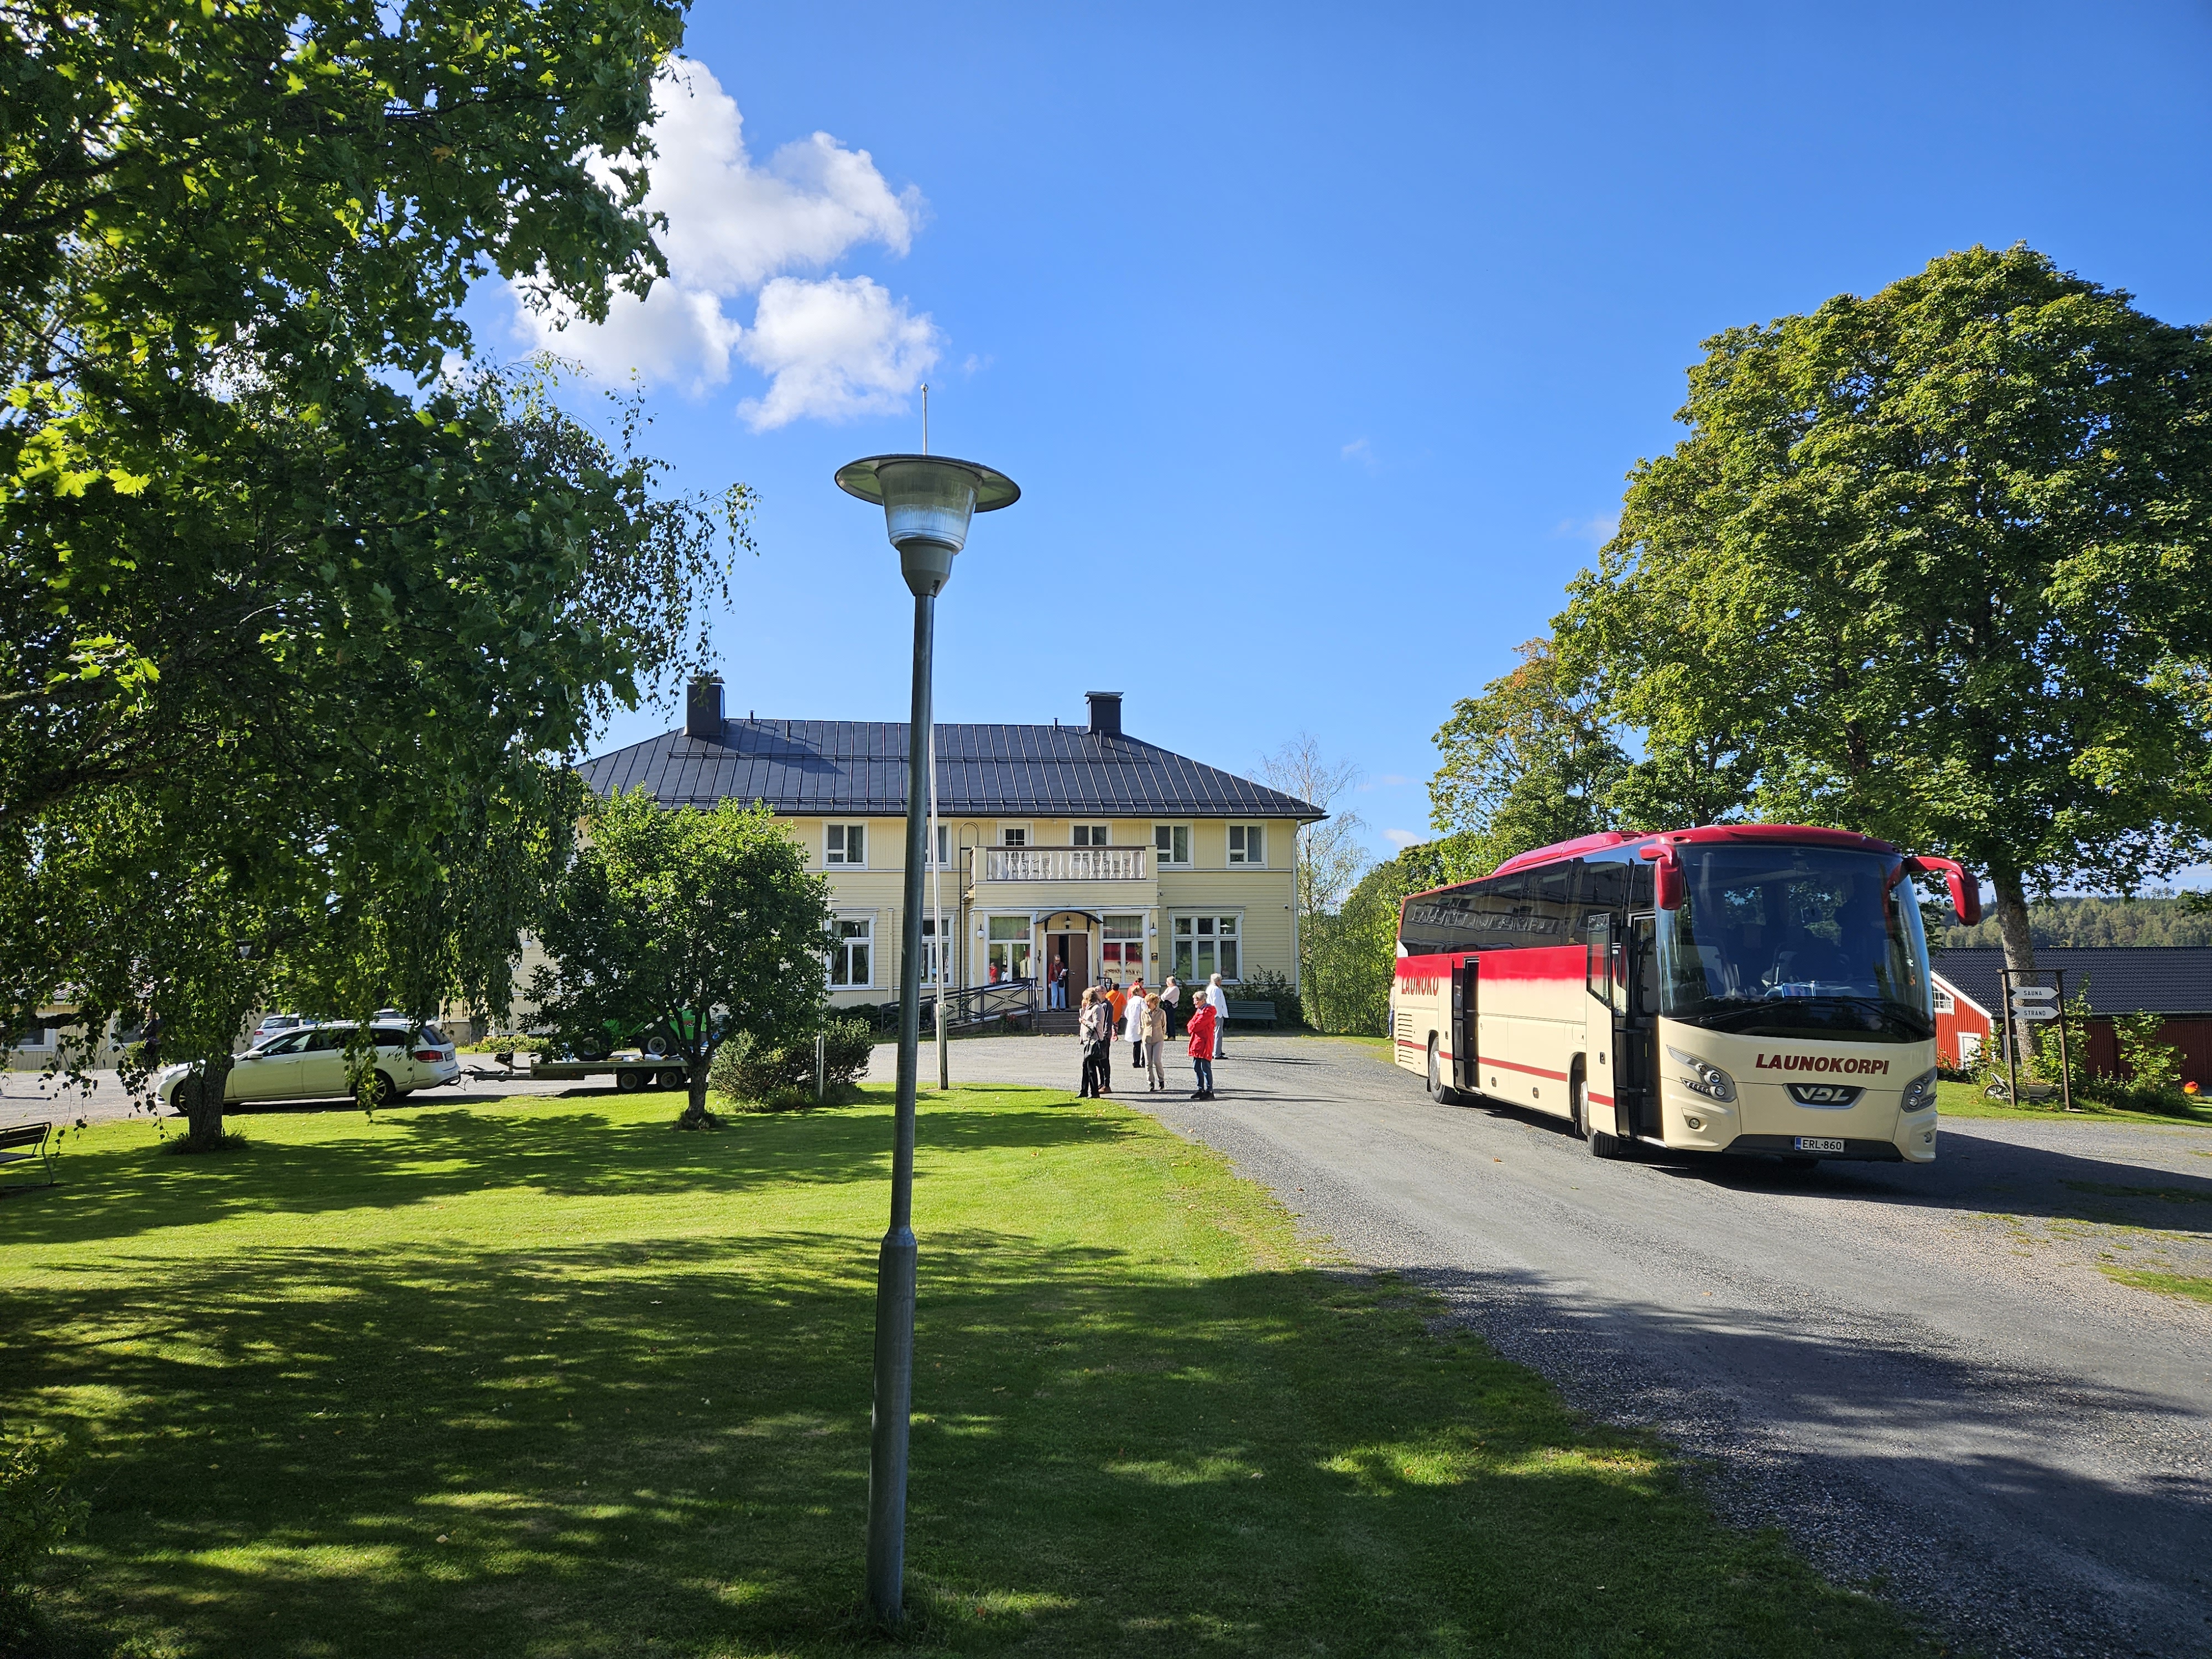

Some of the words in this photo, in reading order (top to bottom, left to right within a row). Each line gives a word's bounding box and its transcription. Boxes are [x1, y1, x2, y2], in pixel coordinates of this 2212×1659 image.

[1756, 1053, 1890, 1074] LAUNOKORPI
[1797, 1087, 1849, 1102] VDL
[1803, 1139, 1841, 1150] ERL-860
